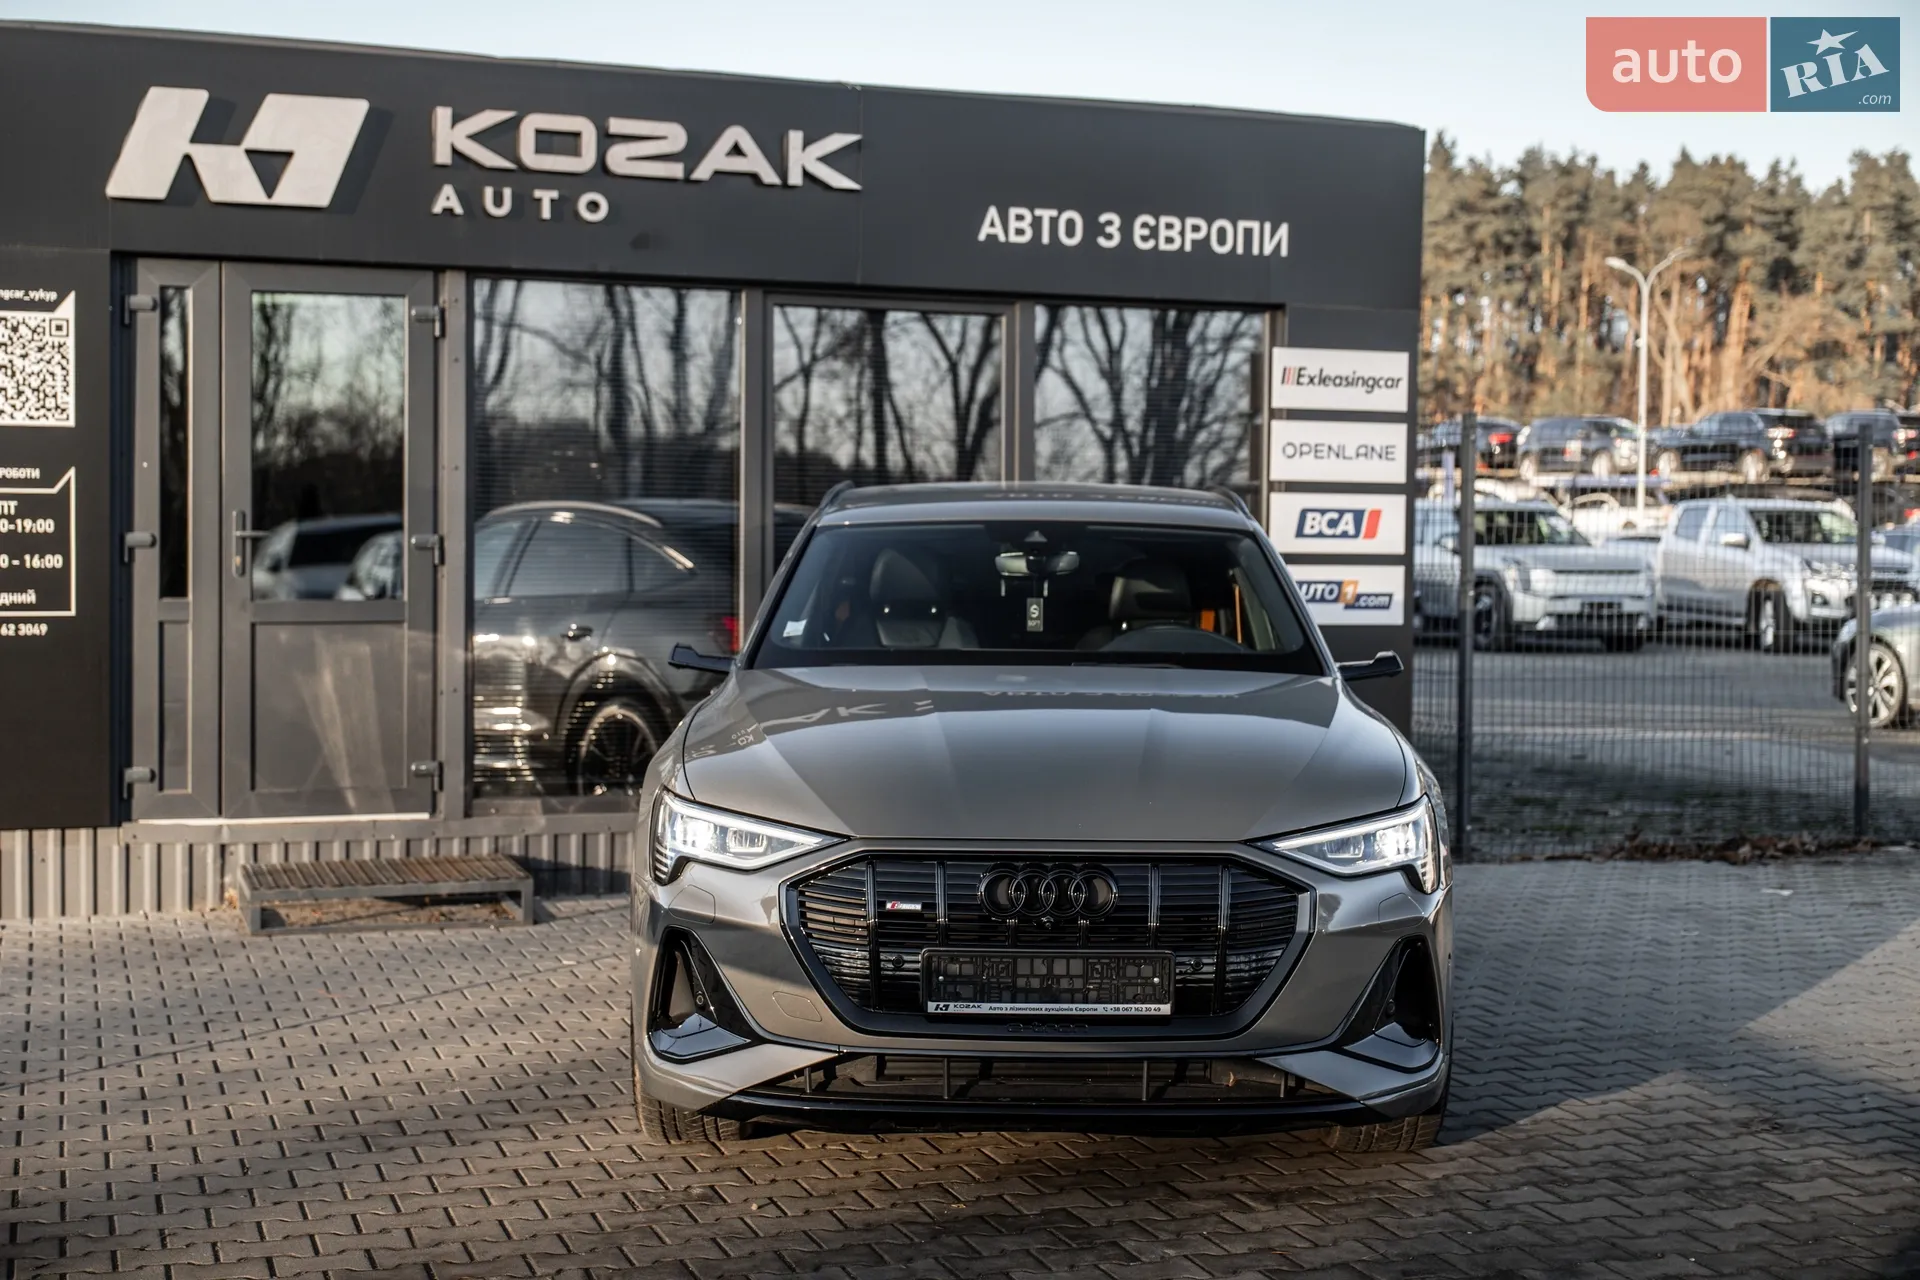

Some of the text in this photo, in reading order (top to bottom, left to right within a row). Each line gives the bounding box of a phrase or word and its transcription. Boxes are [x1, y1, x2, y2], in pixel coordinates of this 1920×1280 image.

[431, 106, 863, 192] KOZAK
[431, 184, 609, 222] AUTO
[977, 204, 1289, 258] АВТО З ЄВРОПИ
[1296, 366, 1403, 394] Exleasingcar
[1282, 442, 1396, 461] OPENLANE
[1303, 511, 1356, 536] BCA
[24, 554, 63, 569] 16:00
[1297, 582, 1390, 608] UTO1.com
[0, 623, 48, 636] 62 3049
